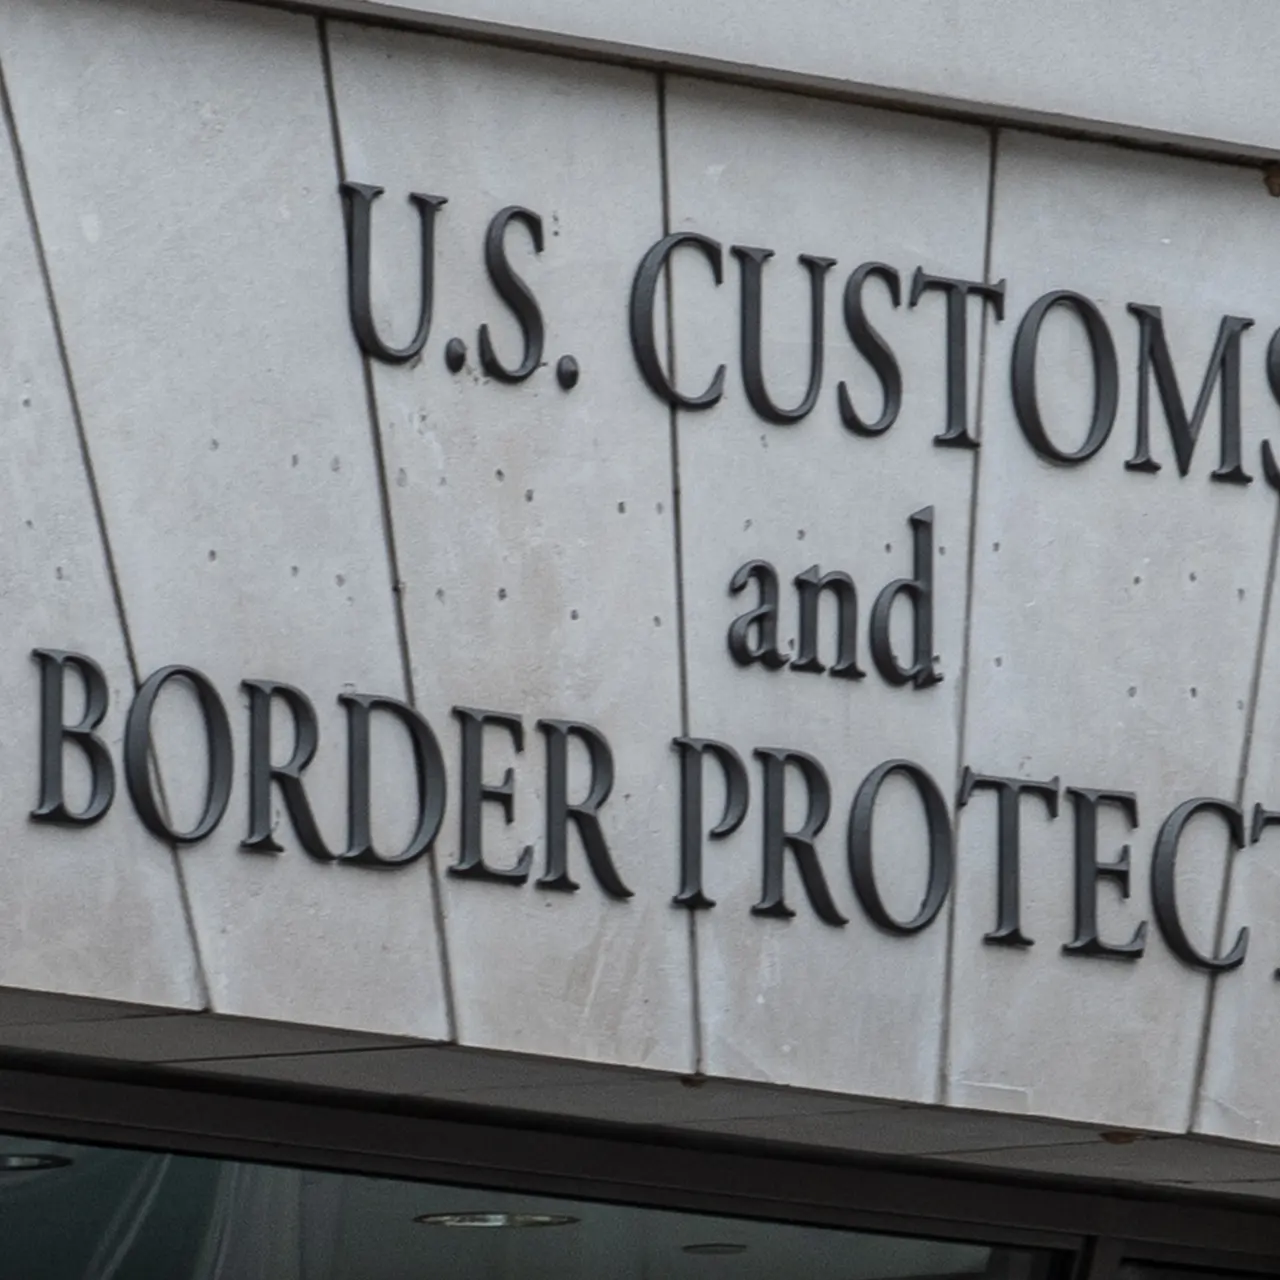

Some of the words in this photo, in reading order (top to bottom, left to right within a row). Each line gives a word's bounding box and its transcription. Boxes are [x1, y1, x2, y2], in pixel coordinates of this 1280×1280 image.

[339, 181, 579, 391] U.S.
[727, 505, 943, 690] and
[29, 647, 634, 899] BORDER
